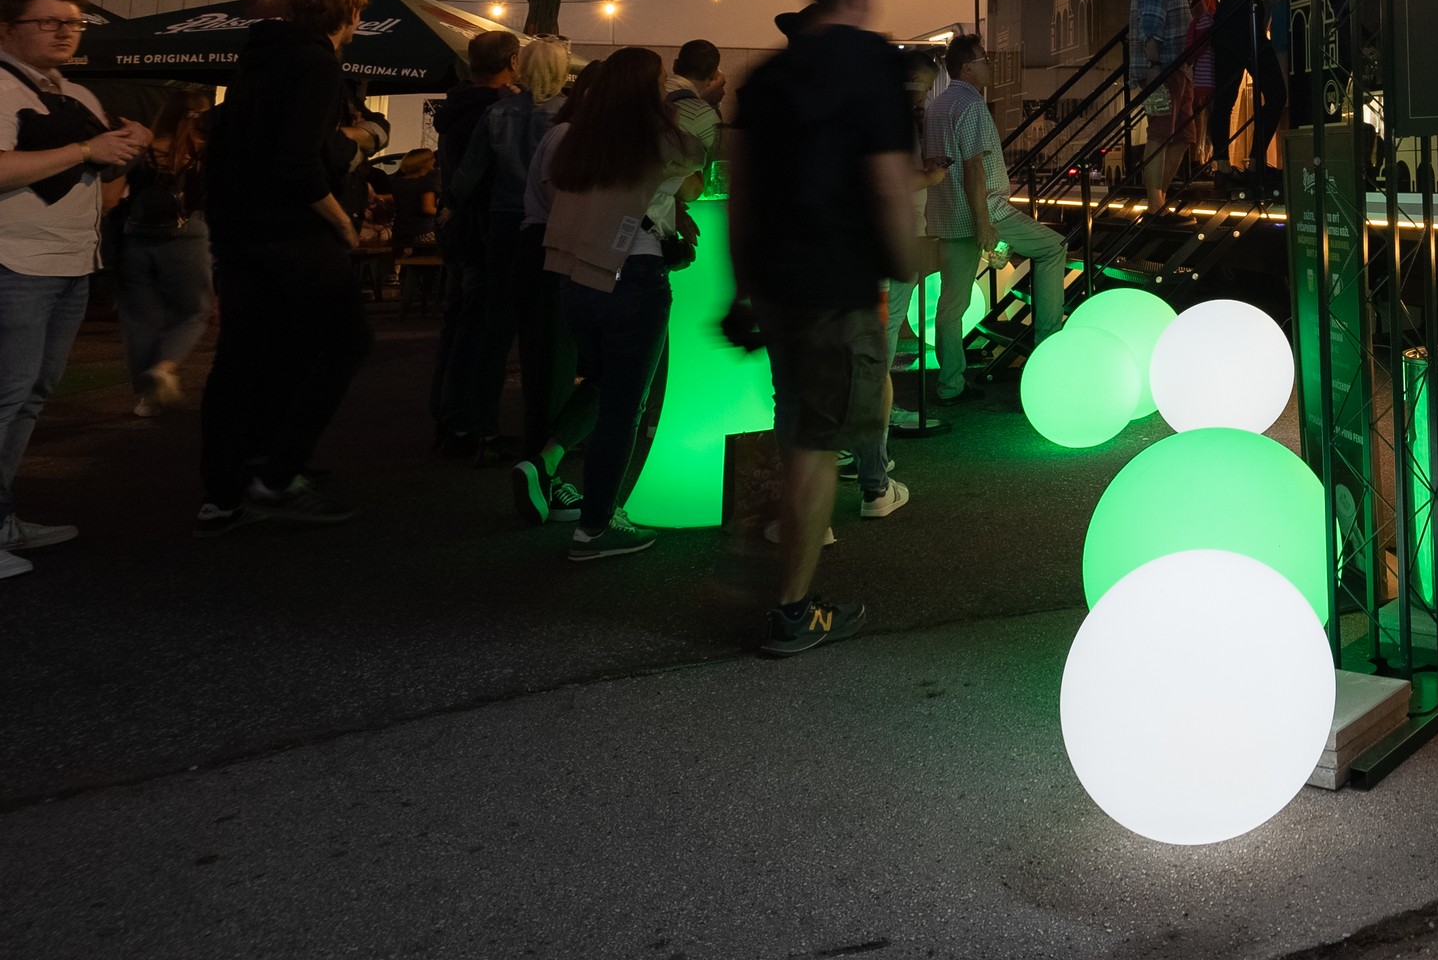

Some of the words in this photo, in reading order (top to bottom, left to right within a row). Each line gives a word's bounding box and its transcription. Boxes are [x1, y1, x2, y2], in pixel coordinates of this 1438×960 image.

[116, 54, 140, 64] THE
[144, 53, 205, 64] ORIGINAL
[342, 62, 398, 76] ORIGINAL
[401, 68, 428, 78] WAY
